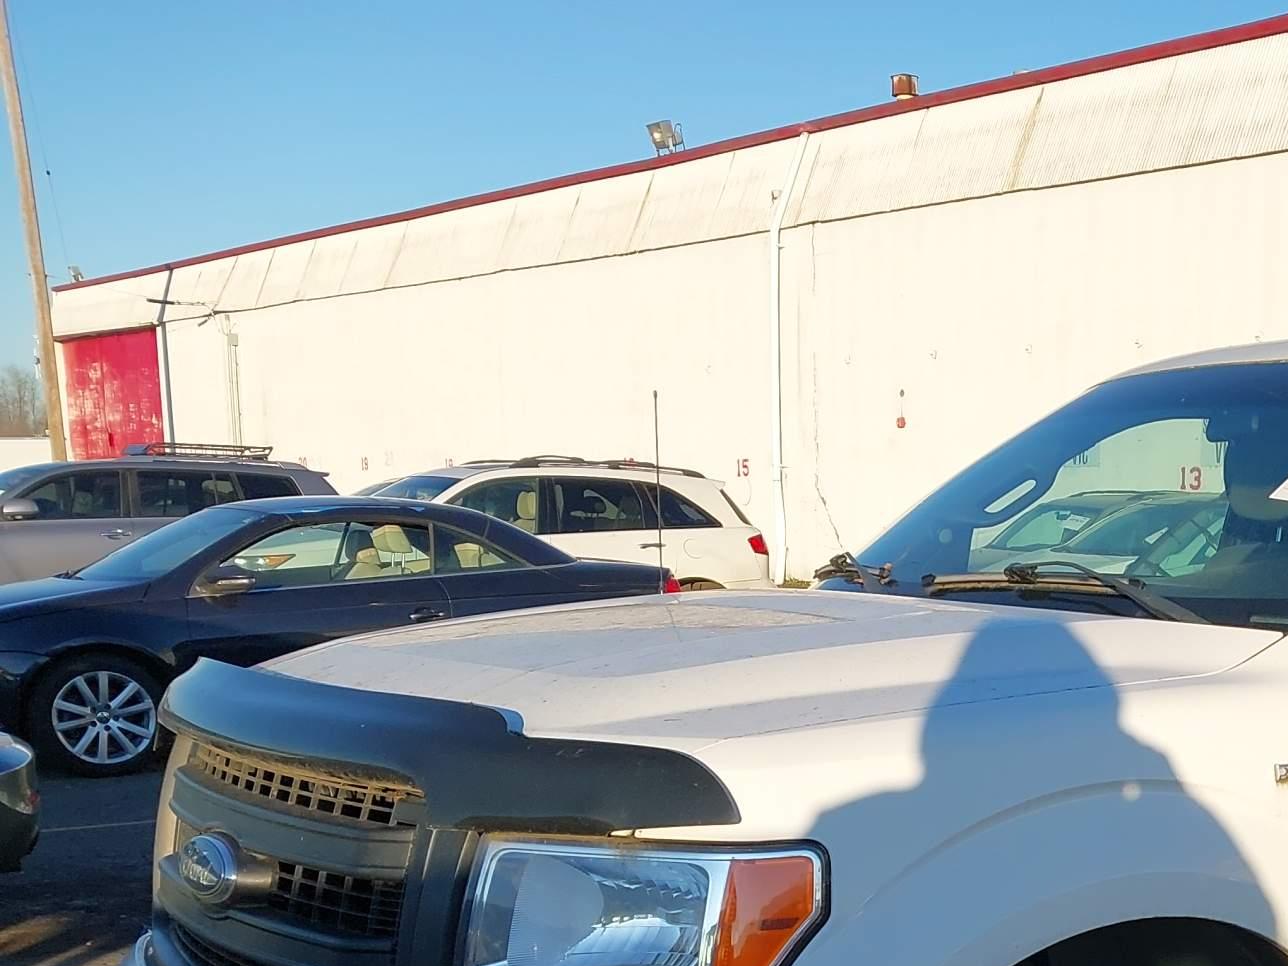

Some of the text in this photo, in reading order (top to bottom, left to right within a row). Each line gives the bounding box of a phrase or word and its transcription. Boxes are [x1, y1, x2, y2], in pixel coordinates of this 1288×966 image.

[361, 456, 369, 471] 19
[736, 458, 750, 477] 15
[1180, 466, 1202, 491] 13
